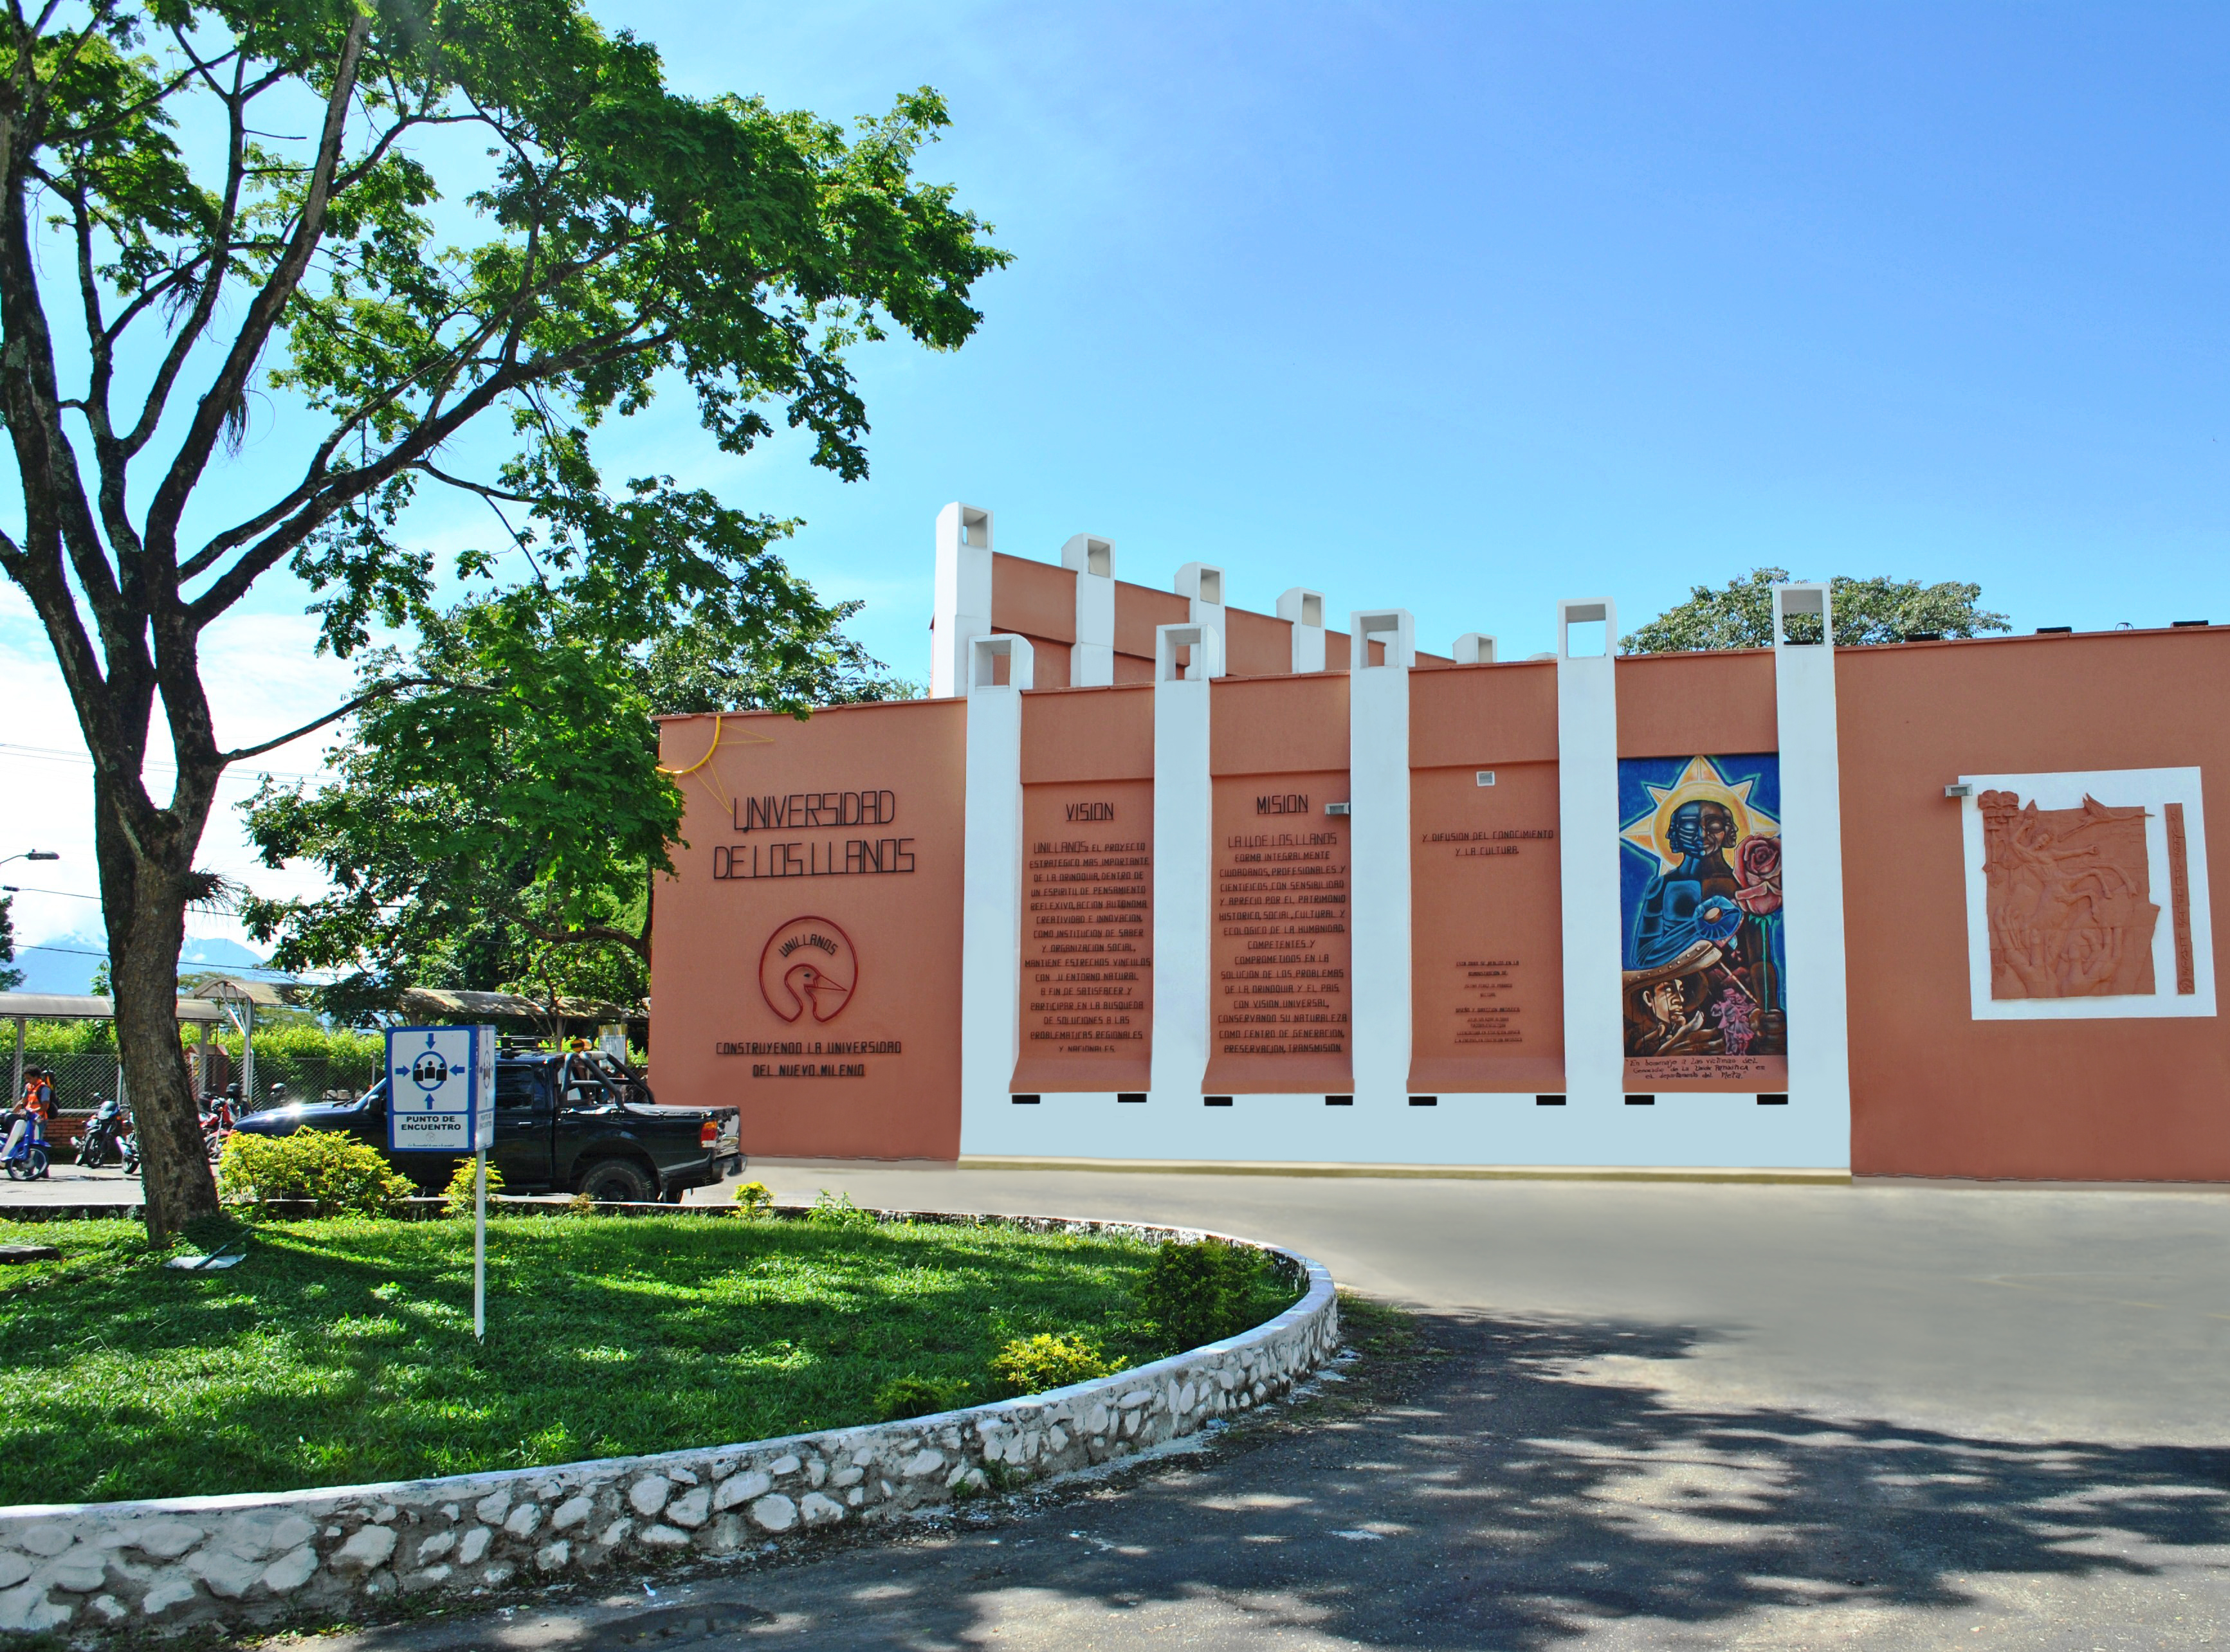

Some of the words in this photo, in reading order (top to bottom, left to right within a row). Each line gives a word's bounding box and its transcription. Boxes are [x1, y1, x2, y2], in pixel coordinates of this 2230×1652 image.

[735, 790, 895, 831] UNIVERSIDAD
[1066, 803, 1114, 821] VISION
[1257, 795, 1308, 814] MISION
[714, 846, 746, 880] DE
[754, 842, 803, 878] LOS
[812, 839, 915, 875] LLANOS
[778, 934, 839, 958] UNILLANOS
[717, 1042, 801, 1055] CONSTRUYENDO
[808, 1042, 822, 1054] LA
[827, 1041, 902, 1054] UNIVERSIDAD
[753, 1064, 773, 1077] DEL
[780, 1064, 814, 1076] NUEVO
[821, 1064, 864, 1076] MILENIO
